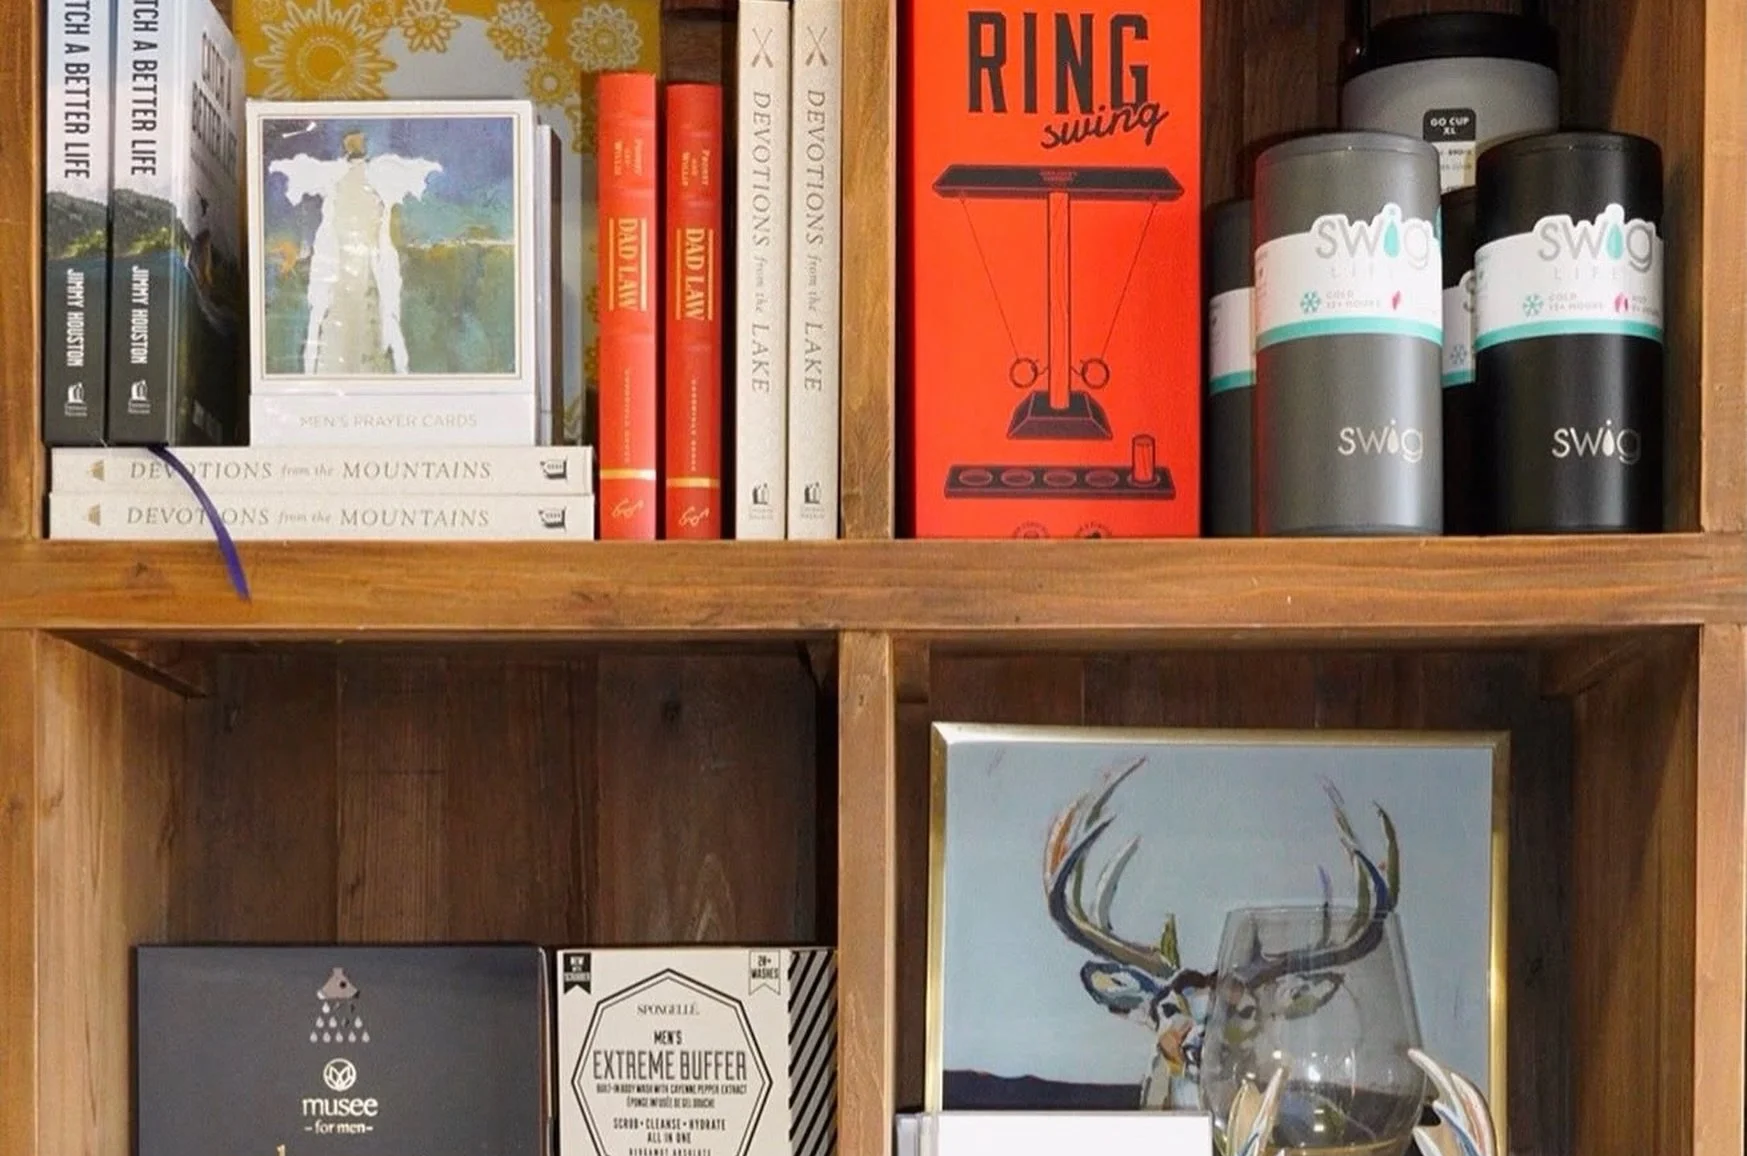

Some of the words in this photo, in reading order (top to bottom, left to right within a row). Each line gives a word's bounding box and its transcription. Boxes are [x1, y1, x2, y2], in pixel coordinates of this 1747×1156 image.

[64, 0, 90, 34] TCH
[133, 0, 159, 32] TCH
[64, 43, 90, 54] A
[133, 40, 158, 51] A
[967, 11, 1149, 115] RING
[64, 63, 90, 134] BETTER
[132, 60, 158, 131] BETTER
[1041, 101, 1169, 150] swing
[1430, 118, 1447, 127] GO
[1449, 117, 1470, 126] CUP
[1443, 127, 1456, 135] XL
[64, 143, 90, 178] LIFE
[131, 140, 156, 175] LIFE
[752, 91, 772, 246] DEVOTIONS
[806, 90, 826, 245] DEVOTIONS
[618, 218, 639, 262] DAD
[685, 228, 705, 271] DAD
[1314, 210, 1431, 271] swig
[1538, 208, 1653, 273] swig
[67, 268, 85, 308] JIMMY
[132, 265, 149, 305] JIMMY
[754, 255, 768, 288] from
[807, 254, 822, 287] from
[618, 266, 639, 311] LAW
[684, 276, 705, 321] LAW
[755, 291, 769, 312] the
[807, 290, 822, 312] the
[67, 312, 85, 367] HOUSTON
[131, 309, 149, 364] HOUSTON
[752, 322, 770, 393] LAKE
[805, 321, 823, 393] LAKE
[354, 415, 417, 428] PRAYER
[422, 414, 477, 428] CARDS
[1338, 418, 1425, 464] swig
[1552, 419, 1642, 465] swig
[281, 463, 309, 477] from
[315, 463, 334, 476] the
[342, 461, 492, 480] MOUNTAINS
[127, 507, 269, 526] DEVOTONS
[279, 511, 307, 526] from
[312, 510, 332, 524] the
[340, 508, 489, 527] MOUNTAINS
[752, 968, 779, 980] WASHES
[654, 1030, 683, 1045] MEN'S
[593, 1050, 675, 1081] EXTREME
[680, 1050, 748, 1081] BUFFER
[302, 1097, 378, 1117] musee
[613, 1117, 639, 1130] SCRUB
[645, 1118, 681, 1130] CLEANSE
[689, 1119, 726, 1131] HYDRATE
[647, 1132, 662, 1144] ALL
[664, 1132, 674, 1143] IN
[676, 1132, 692, 1144] ONE
